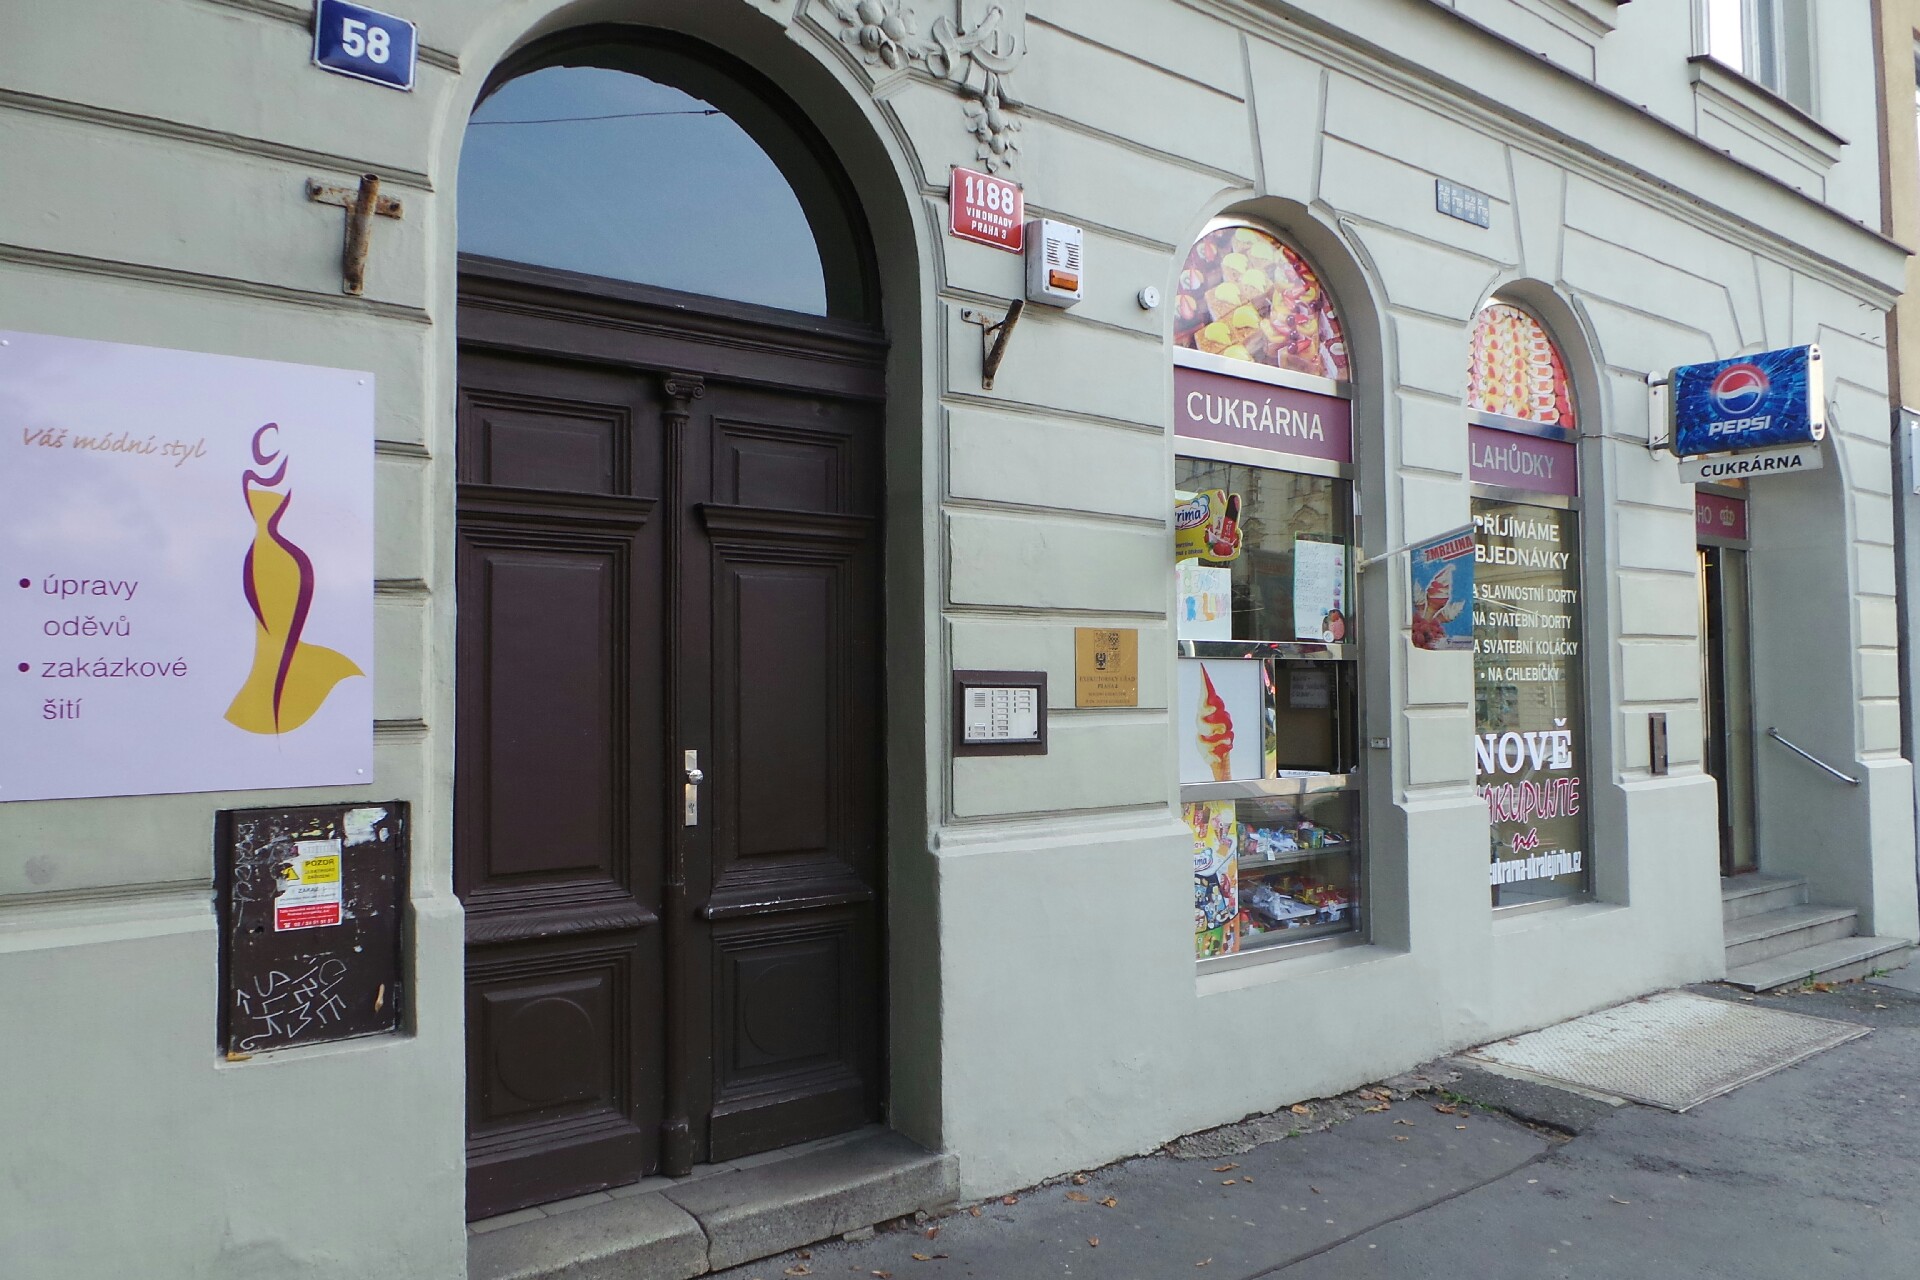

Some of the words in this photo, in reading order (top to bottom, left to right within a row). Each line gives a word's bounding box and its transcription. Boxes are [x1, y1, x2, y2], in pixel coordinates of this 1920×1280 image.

[342, 17, 390, 64] 58
[965, 176, 1014, 215] 1188
[966, 206, 1013, 229] VINOHRADY
[971, 220, 999, 237] PRAHA
[1001, 229, 1007, 240] 3
[1186, 391, 1324, 442] CUKRÁRNA
[1708, 415, 1772, 437] PEPSI
[22, 427, 68, 449] Váš
[72, 432, 157, 456] módní
[161, 437, 208, 468] styl
[1471, 443, 1555, 479] LAHŮDKY
[1700, 454, 1802, 477] CUKRÁRNA
[1175, 509, 1201, 523] rima
[1697, 505, 1712, 524] HO
[1424, 535, 1473, 561] ZMRZLINA
[1475, 543, 1570, 570] BJEDNÁVKY
[42, 574, 138, 600] úpravy
[1481, 584, 1545, 602] SLAVNOSTNÍ
[1547, 589, 1577, 604] DORTY
[43, 615, 130, 636] oděvů
[1472, 611, 1486, 626] NA
[1489, 610, 1539, 628] SVATEBNÍ
[1541, 615, 1572, 629] DORTY
[1473, 639, 1481, 654] A
[1483, 637, 1534, 654] SVATEBNÍ
[1536, 637, 1578, 655] KOLÁČKY
[41, 657, 188, 678] zakázkové
[1488, 667, 1503, 681] NA
[1505, 663, 1560, 681] CHLEBÍČKY
[42, 697, 82, 719] šití
[1475, 718, 1572, 775] NOVĚ
[1478, 777, 1580, 825] AKUPUJTE
